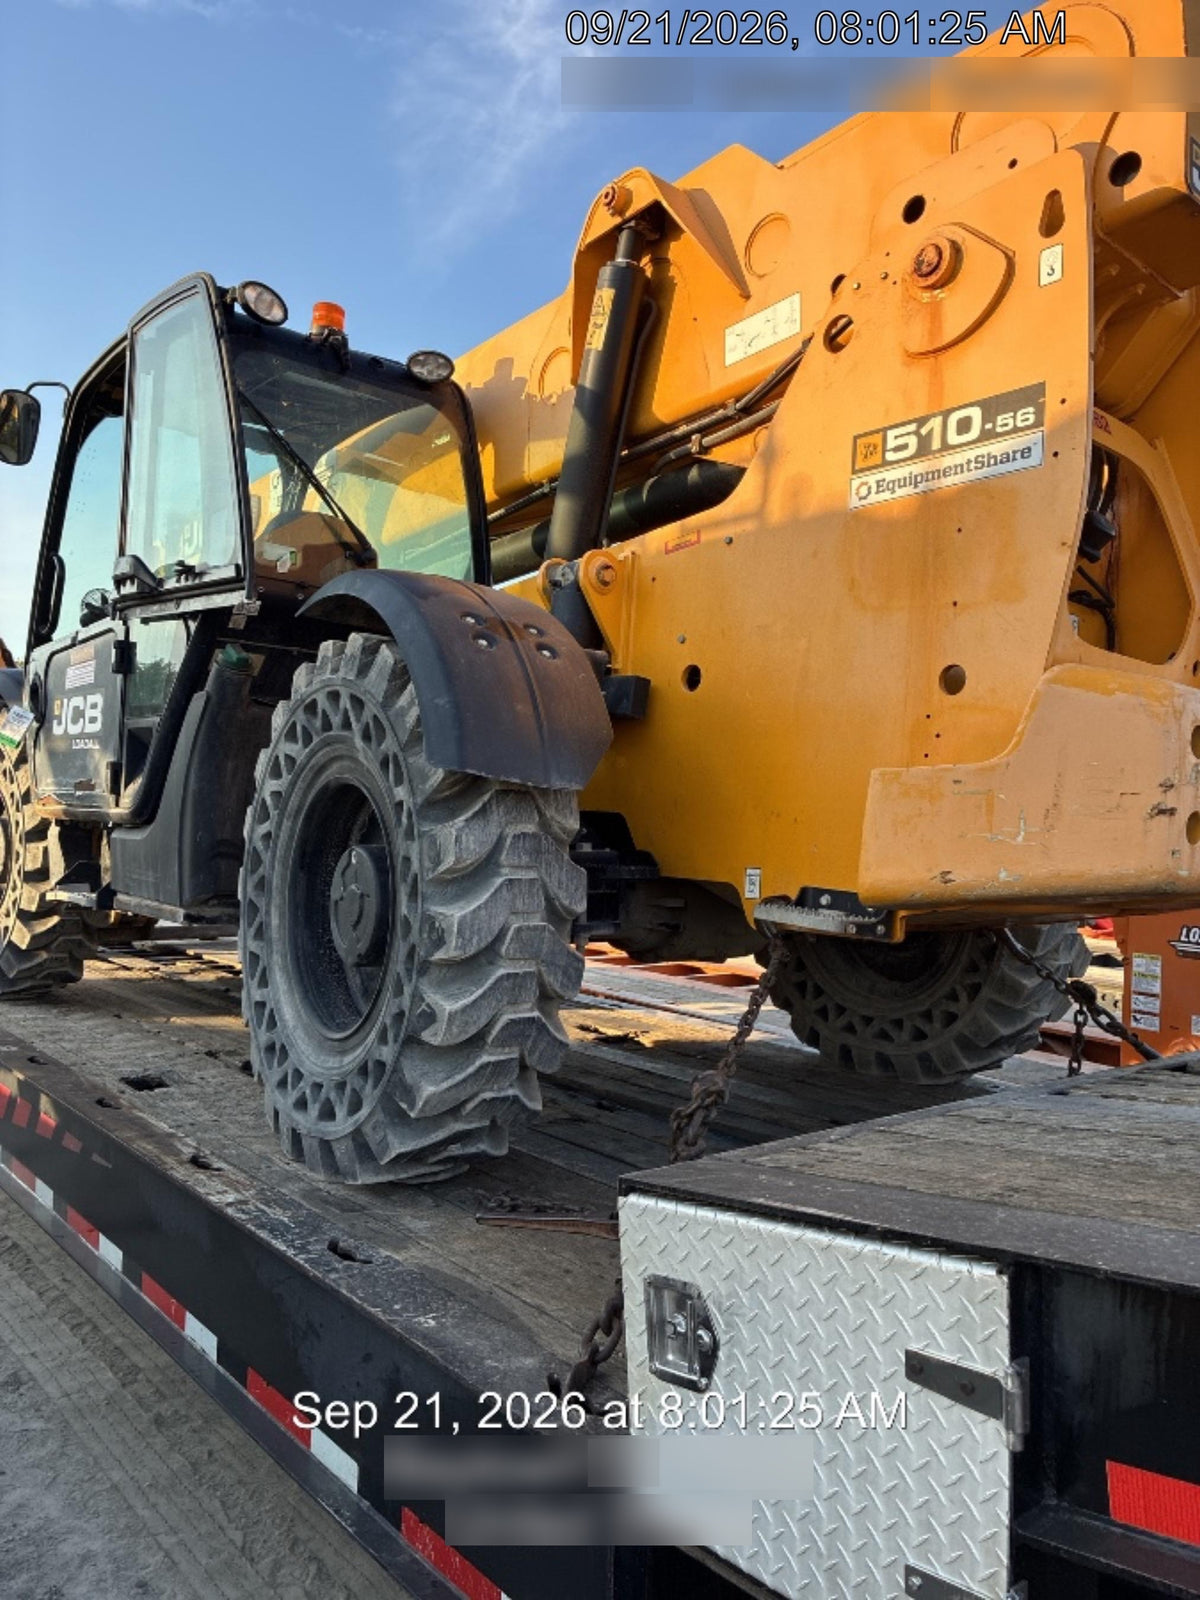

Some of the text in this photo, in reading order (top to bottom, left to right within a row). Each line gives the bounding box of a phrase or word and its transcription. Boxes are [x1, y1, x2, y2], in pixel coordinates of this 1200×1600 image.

[874, 446, 1032, 495] EquipmentShare
[53, 693, 103, 735] JCB
[1180, 927, 1200, 942] LO
